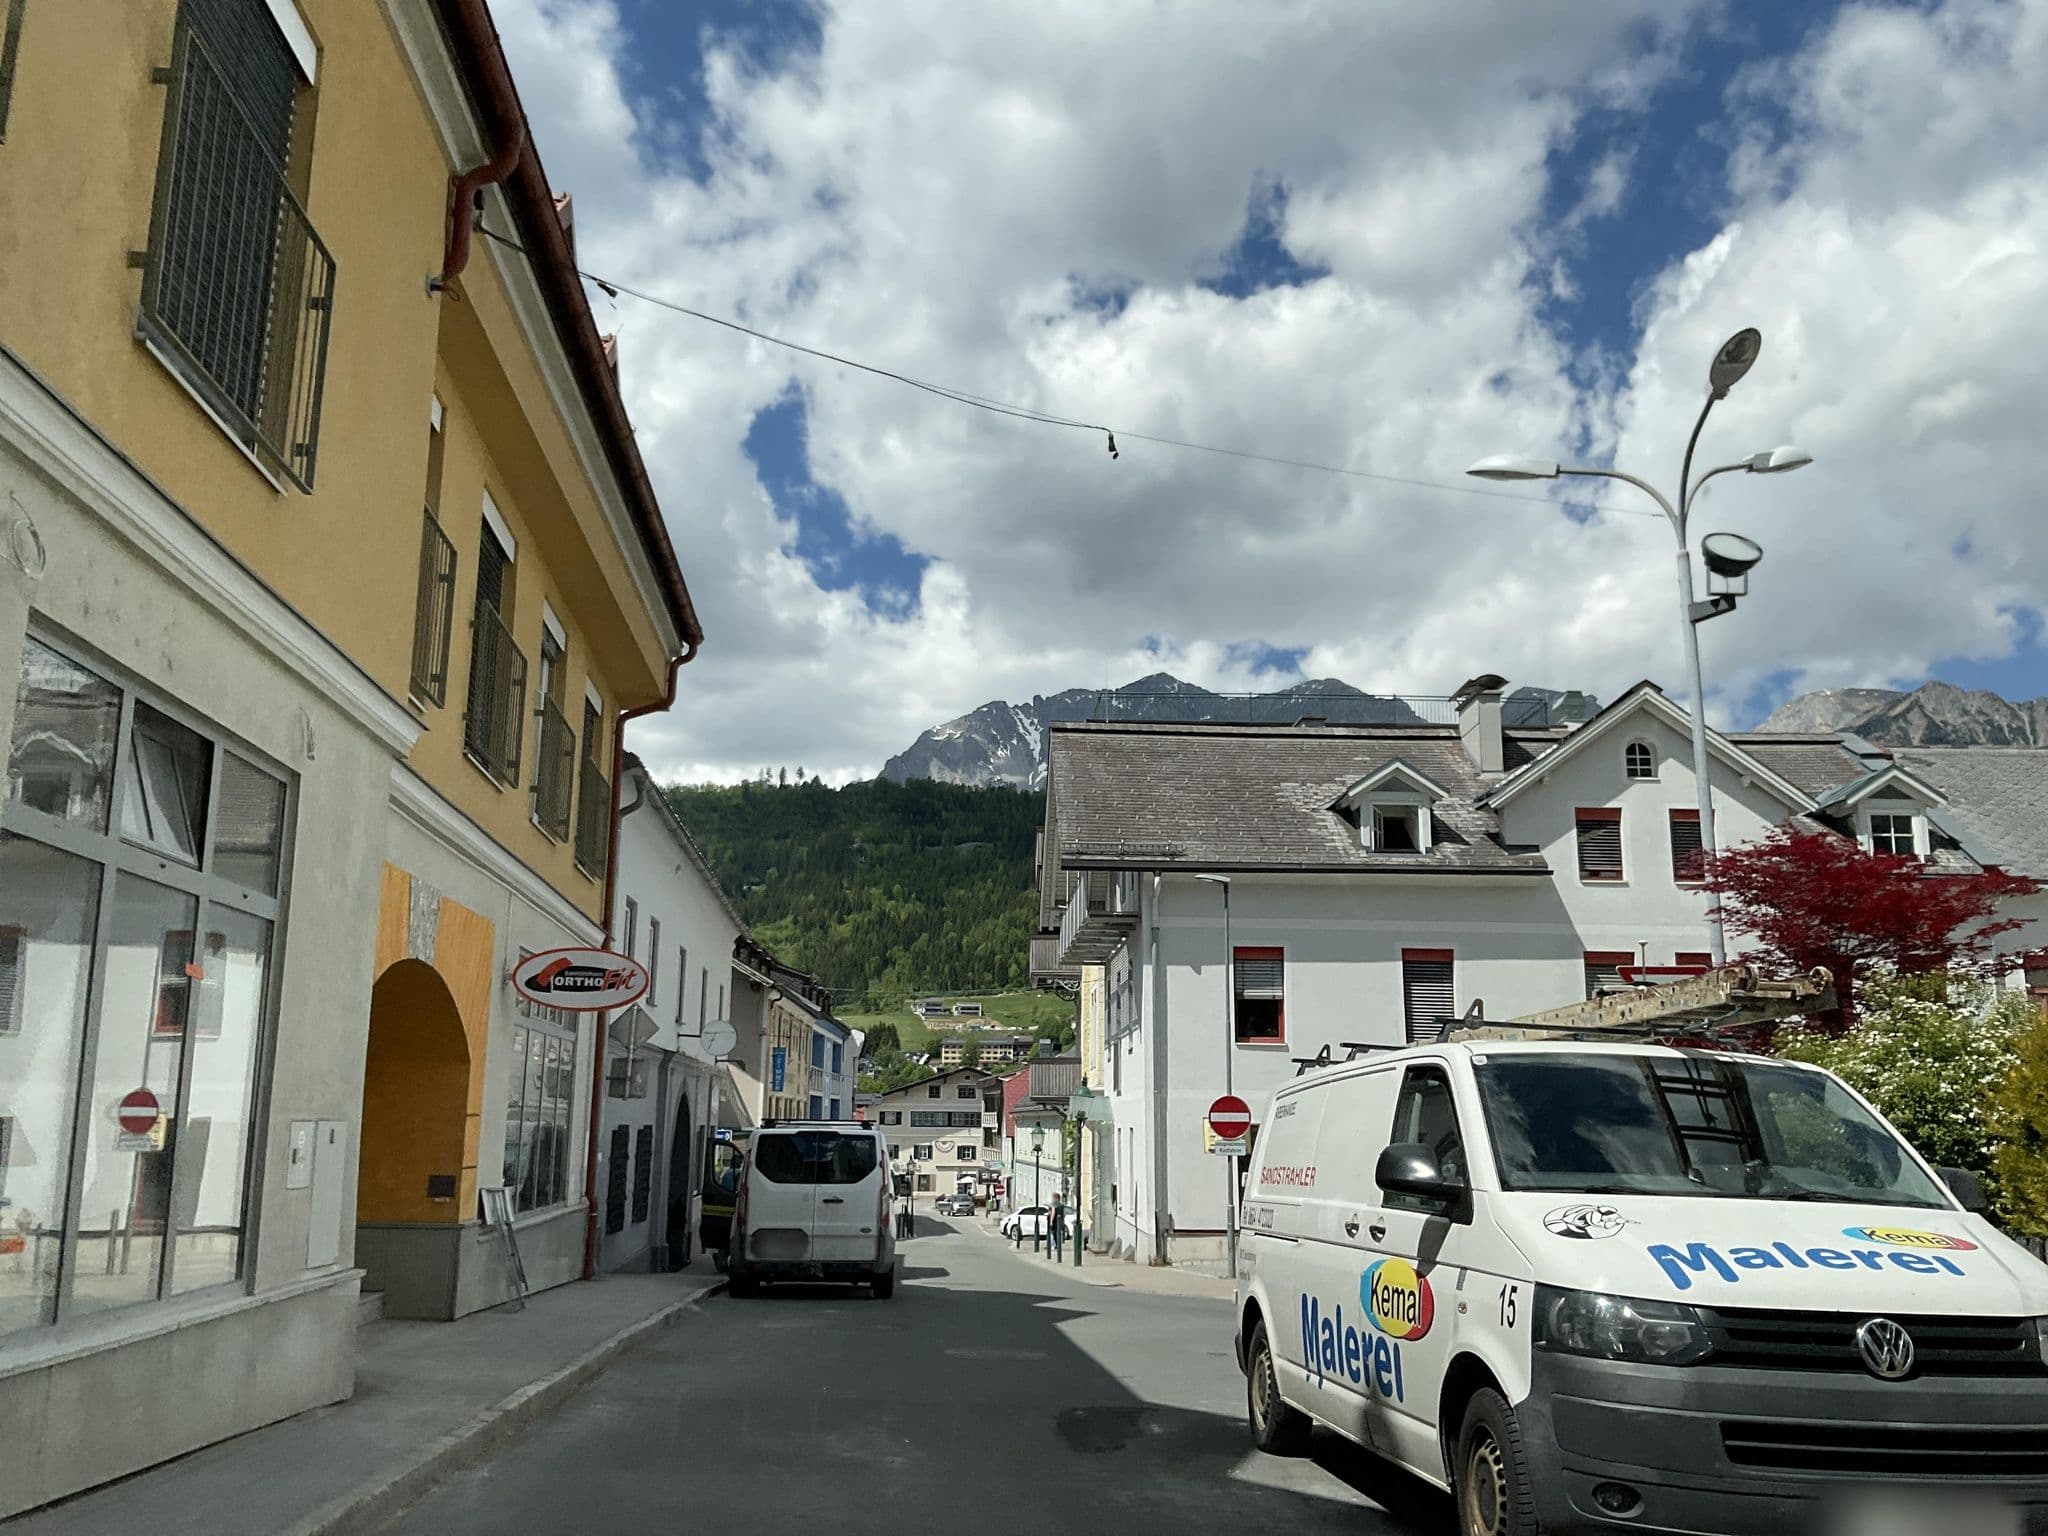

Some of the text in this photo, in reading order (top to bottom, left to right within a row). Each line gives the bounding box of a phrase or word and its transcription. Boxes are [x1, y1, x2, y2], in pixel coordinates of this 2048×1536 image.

[1260, 1166, 1317, 1187] SANDSTRAHLER
[1858, 1228, 1959, 1249] Kemal
[1369, 1271, 1424, 1328] Kemal
[1498, 1283, 1518, 1329] 15
